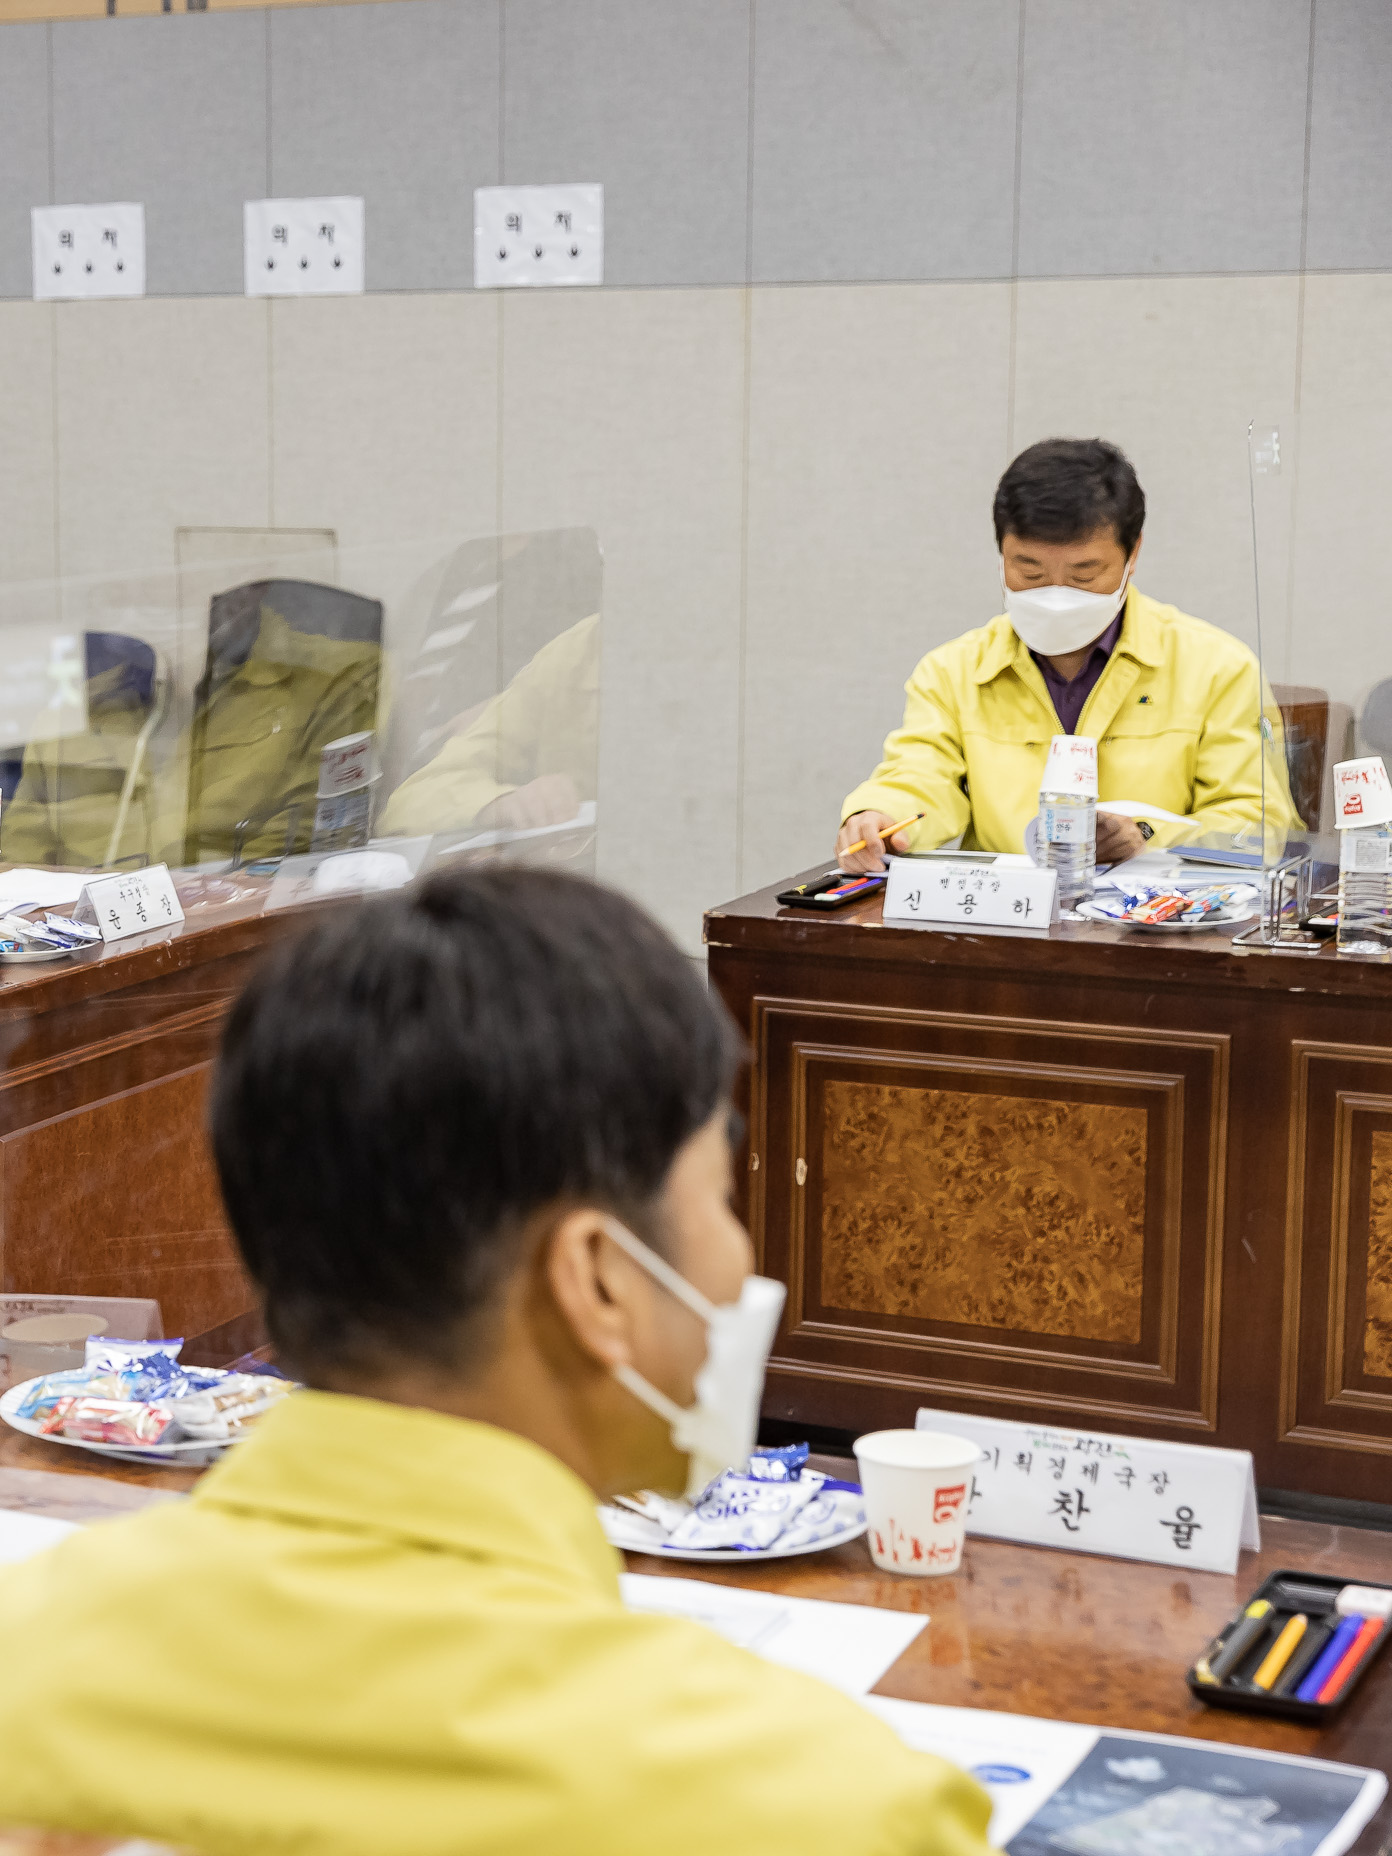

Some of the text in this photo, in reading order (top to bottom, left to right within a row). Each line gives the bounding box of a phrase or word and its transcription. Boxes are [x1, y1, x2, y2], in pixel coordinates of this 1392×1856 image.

[107, 894, 173, 932] 윤종장
[902, 890, 1033, 920] 신용하
[981, 1446, 1172, 1496] 기획경제국장
